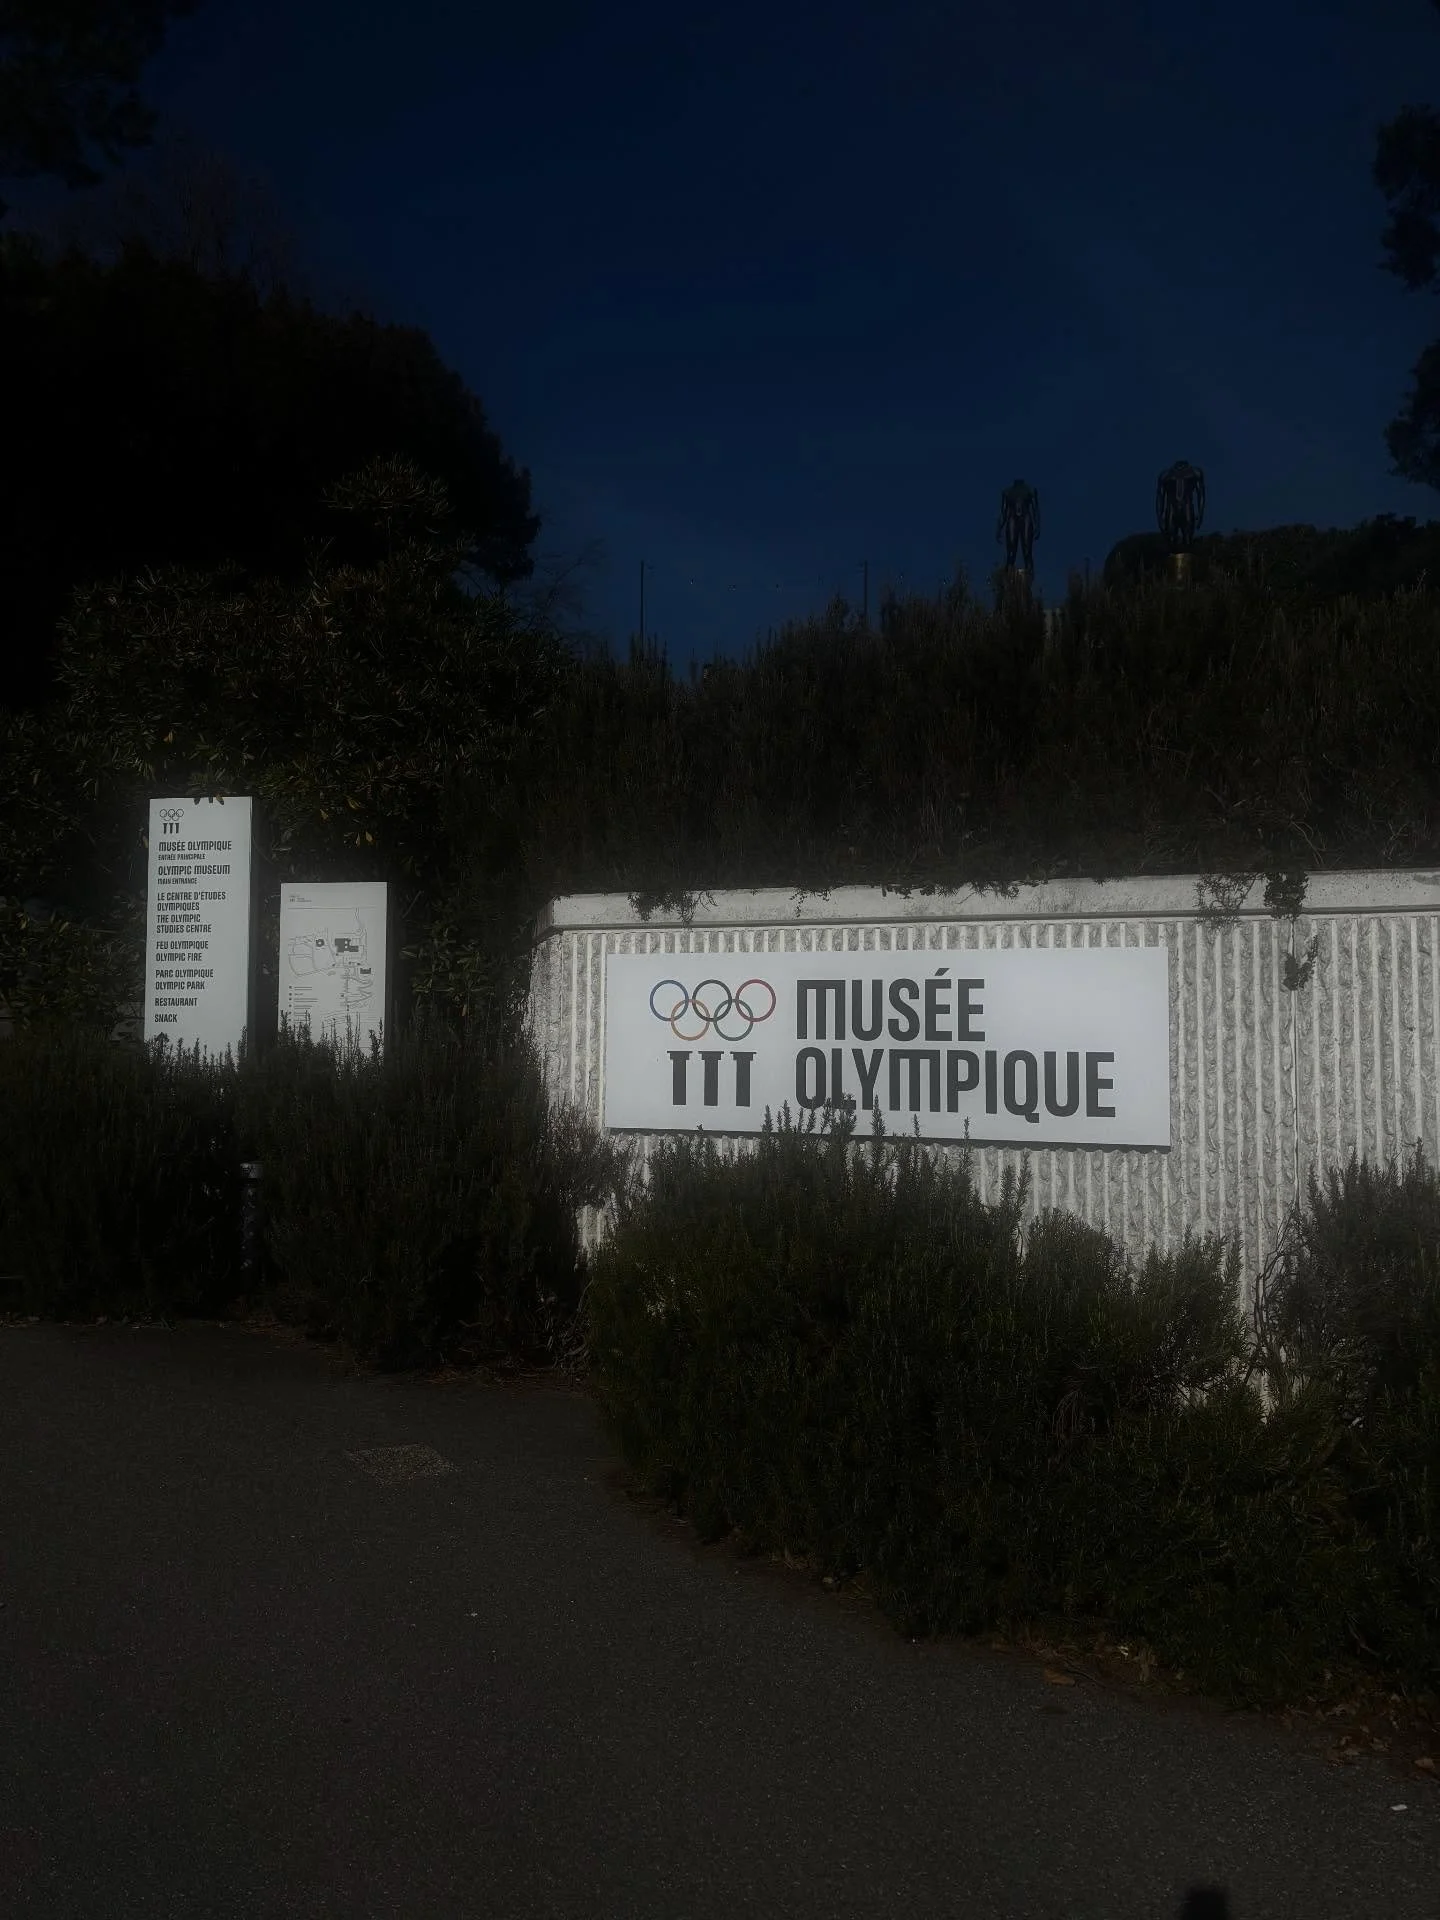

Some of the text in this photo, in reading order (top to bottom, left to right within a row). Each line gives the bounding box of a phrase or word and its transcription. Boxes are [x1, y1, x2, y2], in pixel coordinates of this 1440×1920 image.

[158, 840, 232, 851] MUSÉE OLYMPIQUE
[158, 865, 230, 875] OLYMPIC MUSEUM
[157, 892, 165, 901] LE
[166, 892, 192, 901] CENTRE
[157, 902, 200, 911] OLYMPIQUES
[157, 914, 200, 923] THE OLYMPIC
[156, 924, 212, 933] STUDIES CENTRE
[156, 940, 209, 950] FEU OLYMPIQUE
[156, 952, 202, 962] OLYMPIC FIRE
[156, 969, 214, 978] PARC OLYMPIQUE
[156, 981, 205, 990] OLYMPIC PARK
[154, 998, 198, 1006] RESTAURANT
[796, 967, 986, 1042] MUSÉE
[154, 1014, 178, 1023] SNACK
[796, 1046, 1116, 1124] OLYMPIQUE
